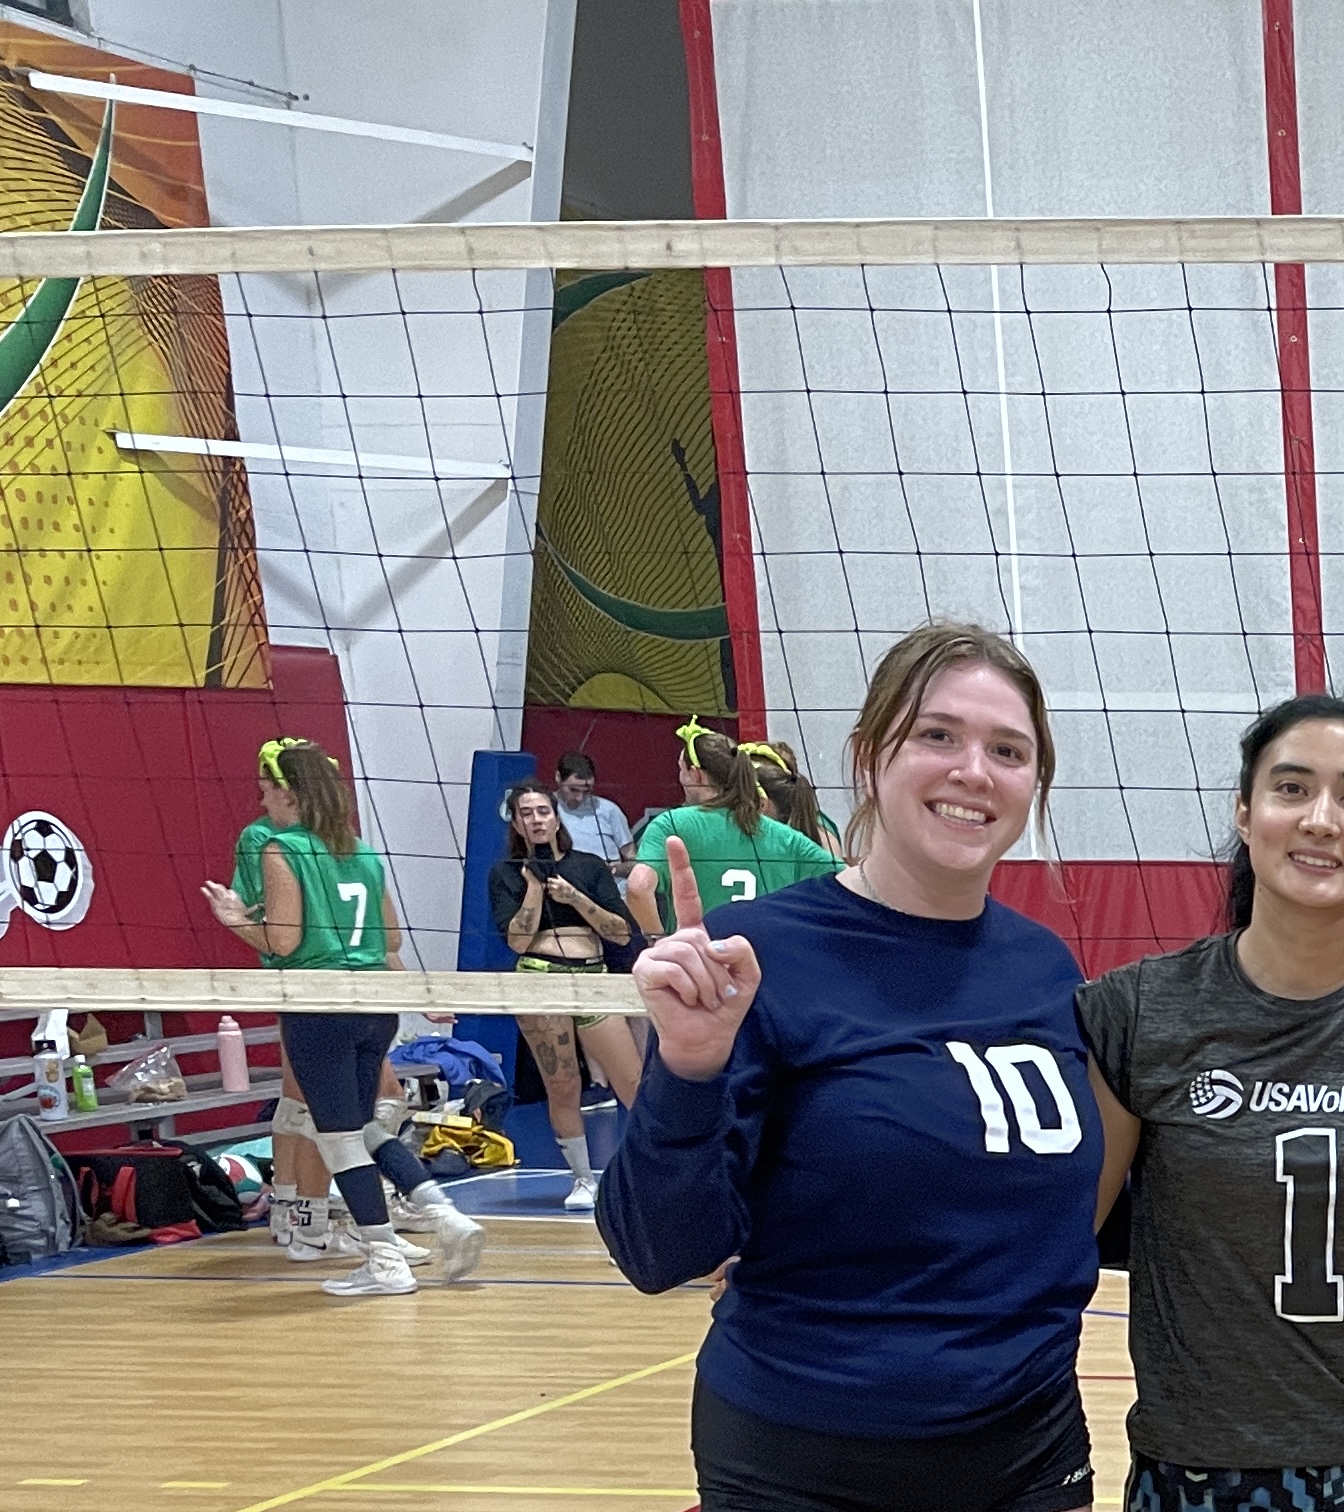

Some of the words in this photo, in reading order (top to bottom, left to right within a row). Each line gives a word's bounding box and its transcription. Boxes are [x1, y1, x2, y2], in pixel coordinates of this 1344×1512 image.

[337, 882, 368, 947] 7
[945, 1040, 1083, 1154] 10
[1274, 1127, 1344, 1322] 1
